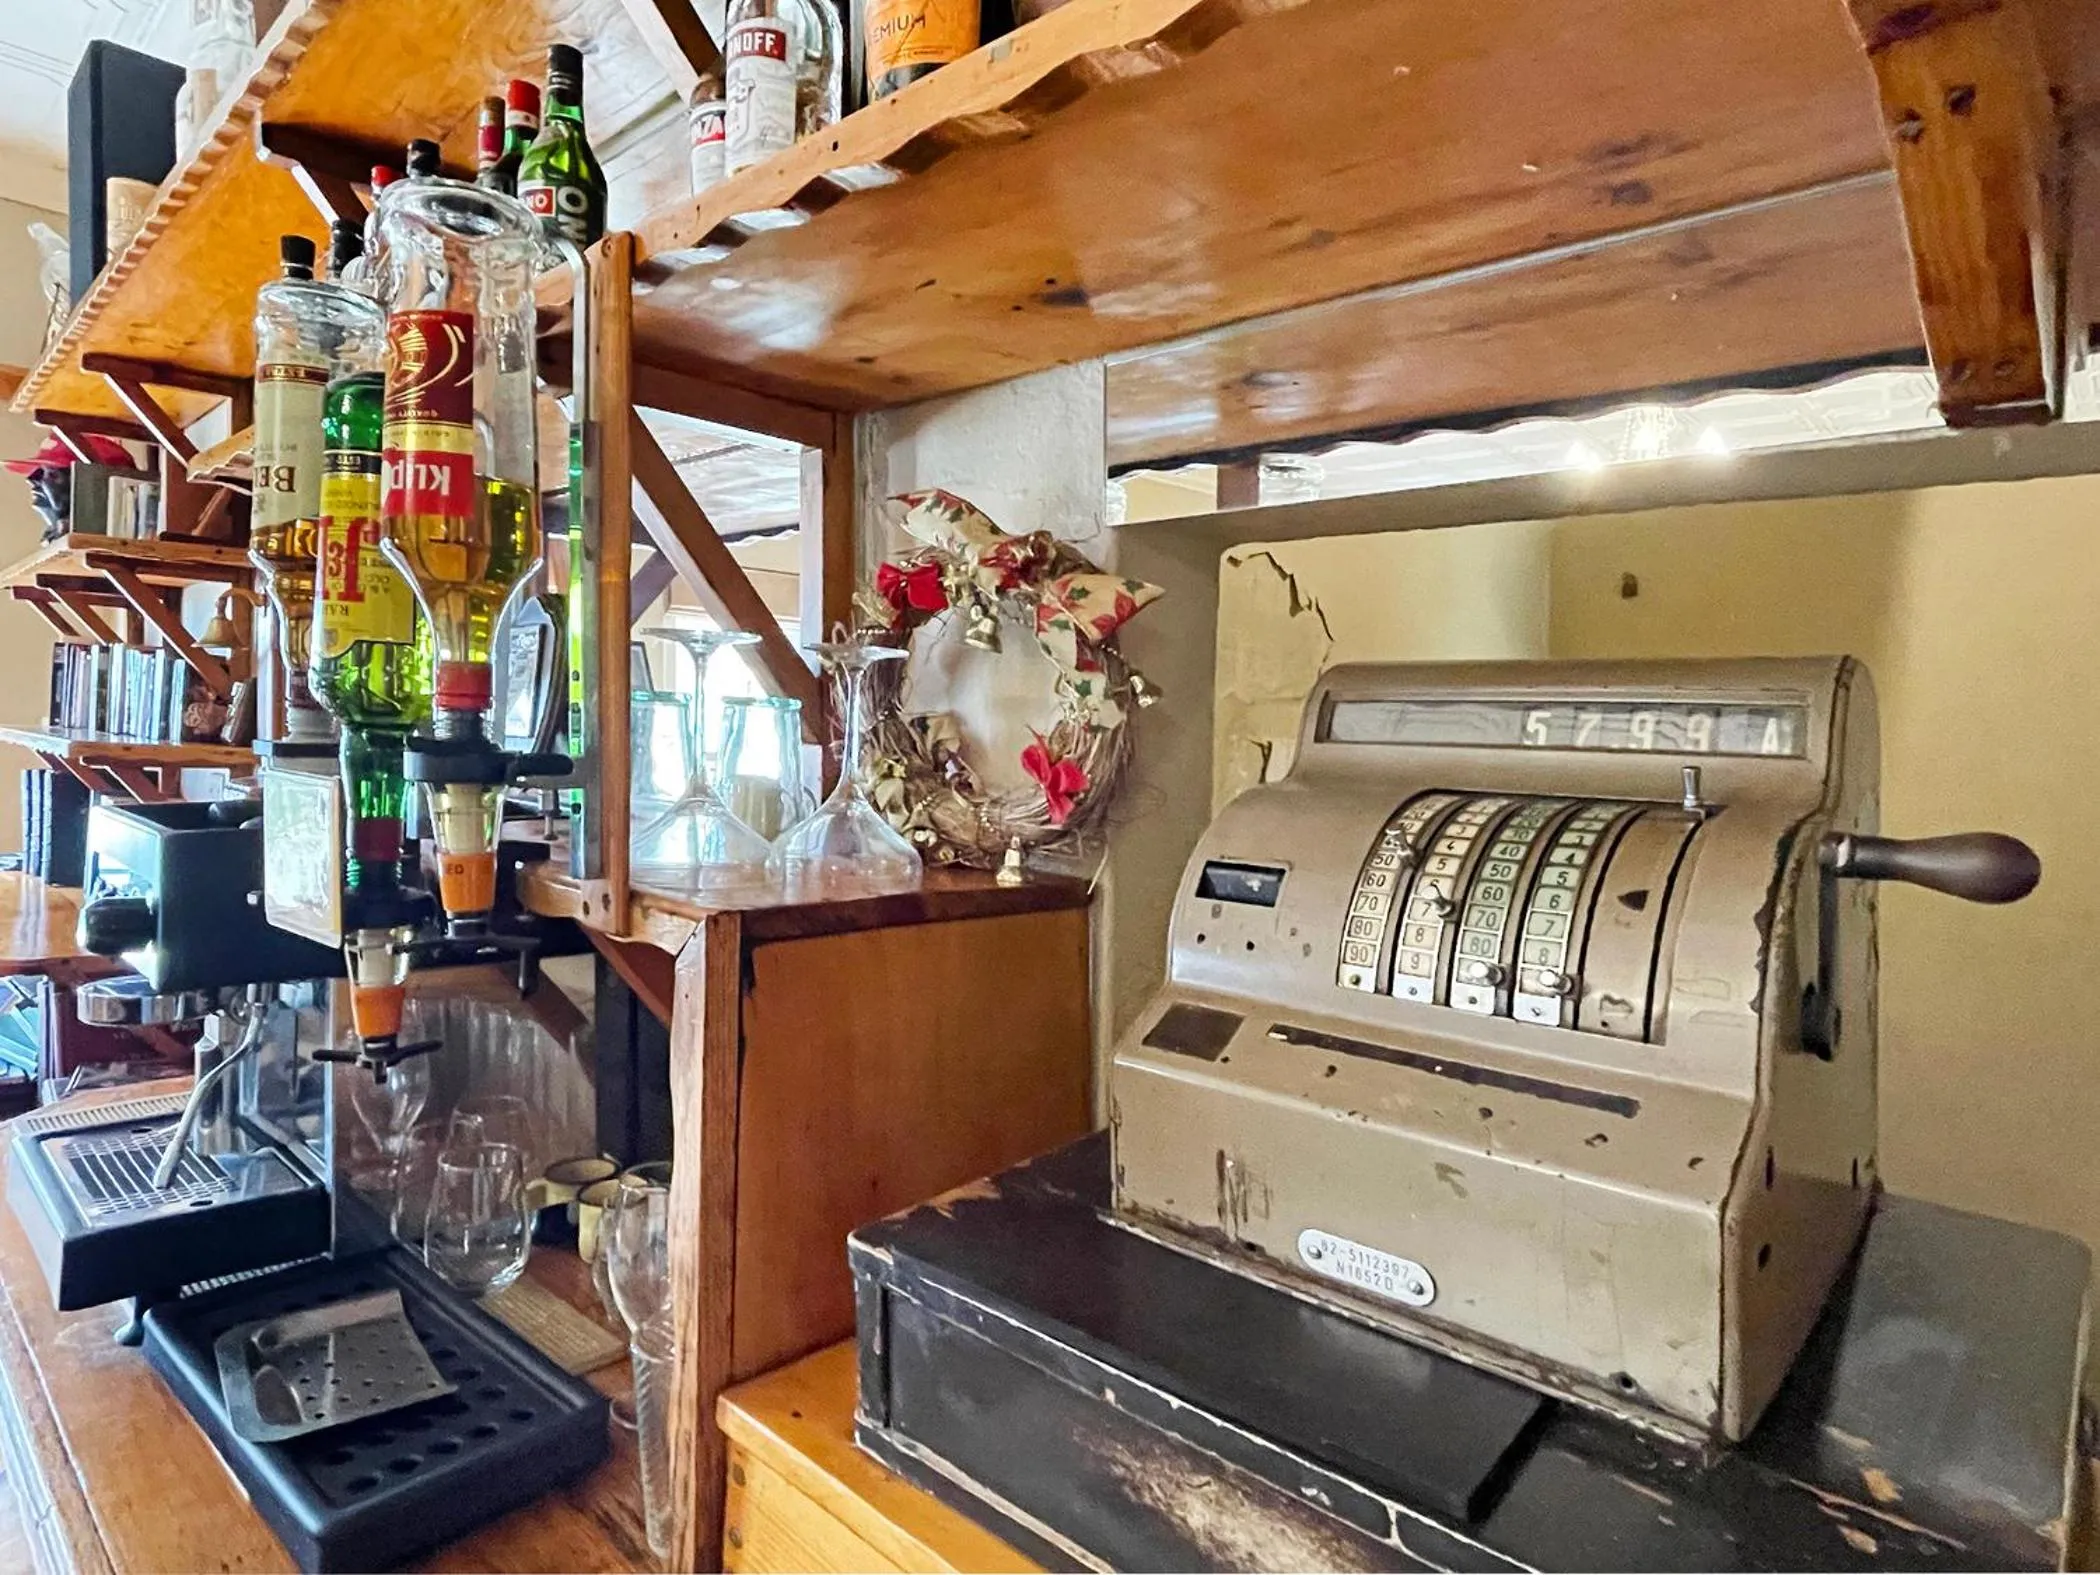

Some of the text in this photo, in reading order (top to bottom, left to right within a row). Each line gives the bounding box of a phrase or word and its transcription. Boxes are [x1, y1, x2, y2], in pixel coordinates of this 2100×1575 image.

[872, 14, 926, 44] EMIUM
[728, 31, 777, 57] NOFF
[319, 515, 381, 604] J&
[1374, 853, 1395, 867] 50
[1498, 846, 1521, 858] 40
[1436, 859, 1448, 871] 5
[1489, 863, 1512, 878] 50
[1366, 874, 1387, 888] 60
[1556, 871, 1569, 886] 5
[1482, 886, 1504, 901] 60
[1549, 894, 1562, 909] 6
[1357, 895, 1378, 912] 70
[1422, 902, 1432, 917] 7
[1477, 909, 1498, 927] 70
[1353, 919, 1373, 936] 80
[1414, 927, 1425, 943] 8
[1543, 919, 1555, 936] 7
[1470, 937, 1492, 954] 80
[1350, 946, 1369, 962] 90
[1410, 954, 1420, 970] 9
[1538, 947, 1550, 966] 8
